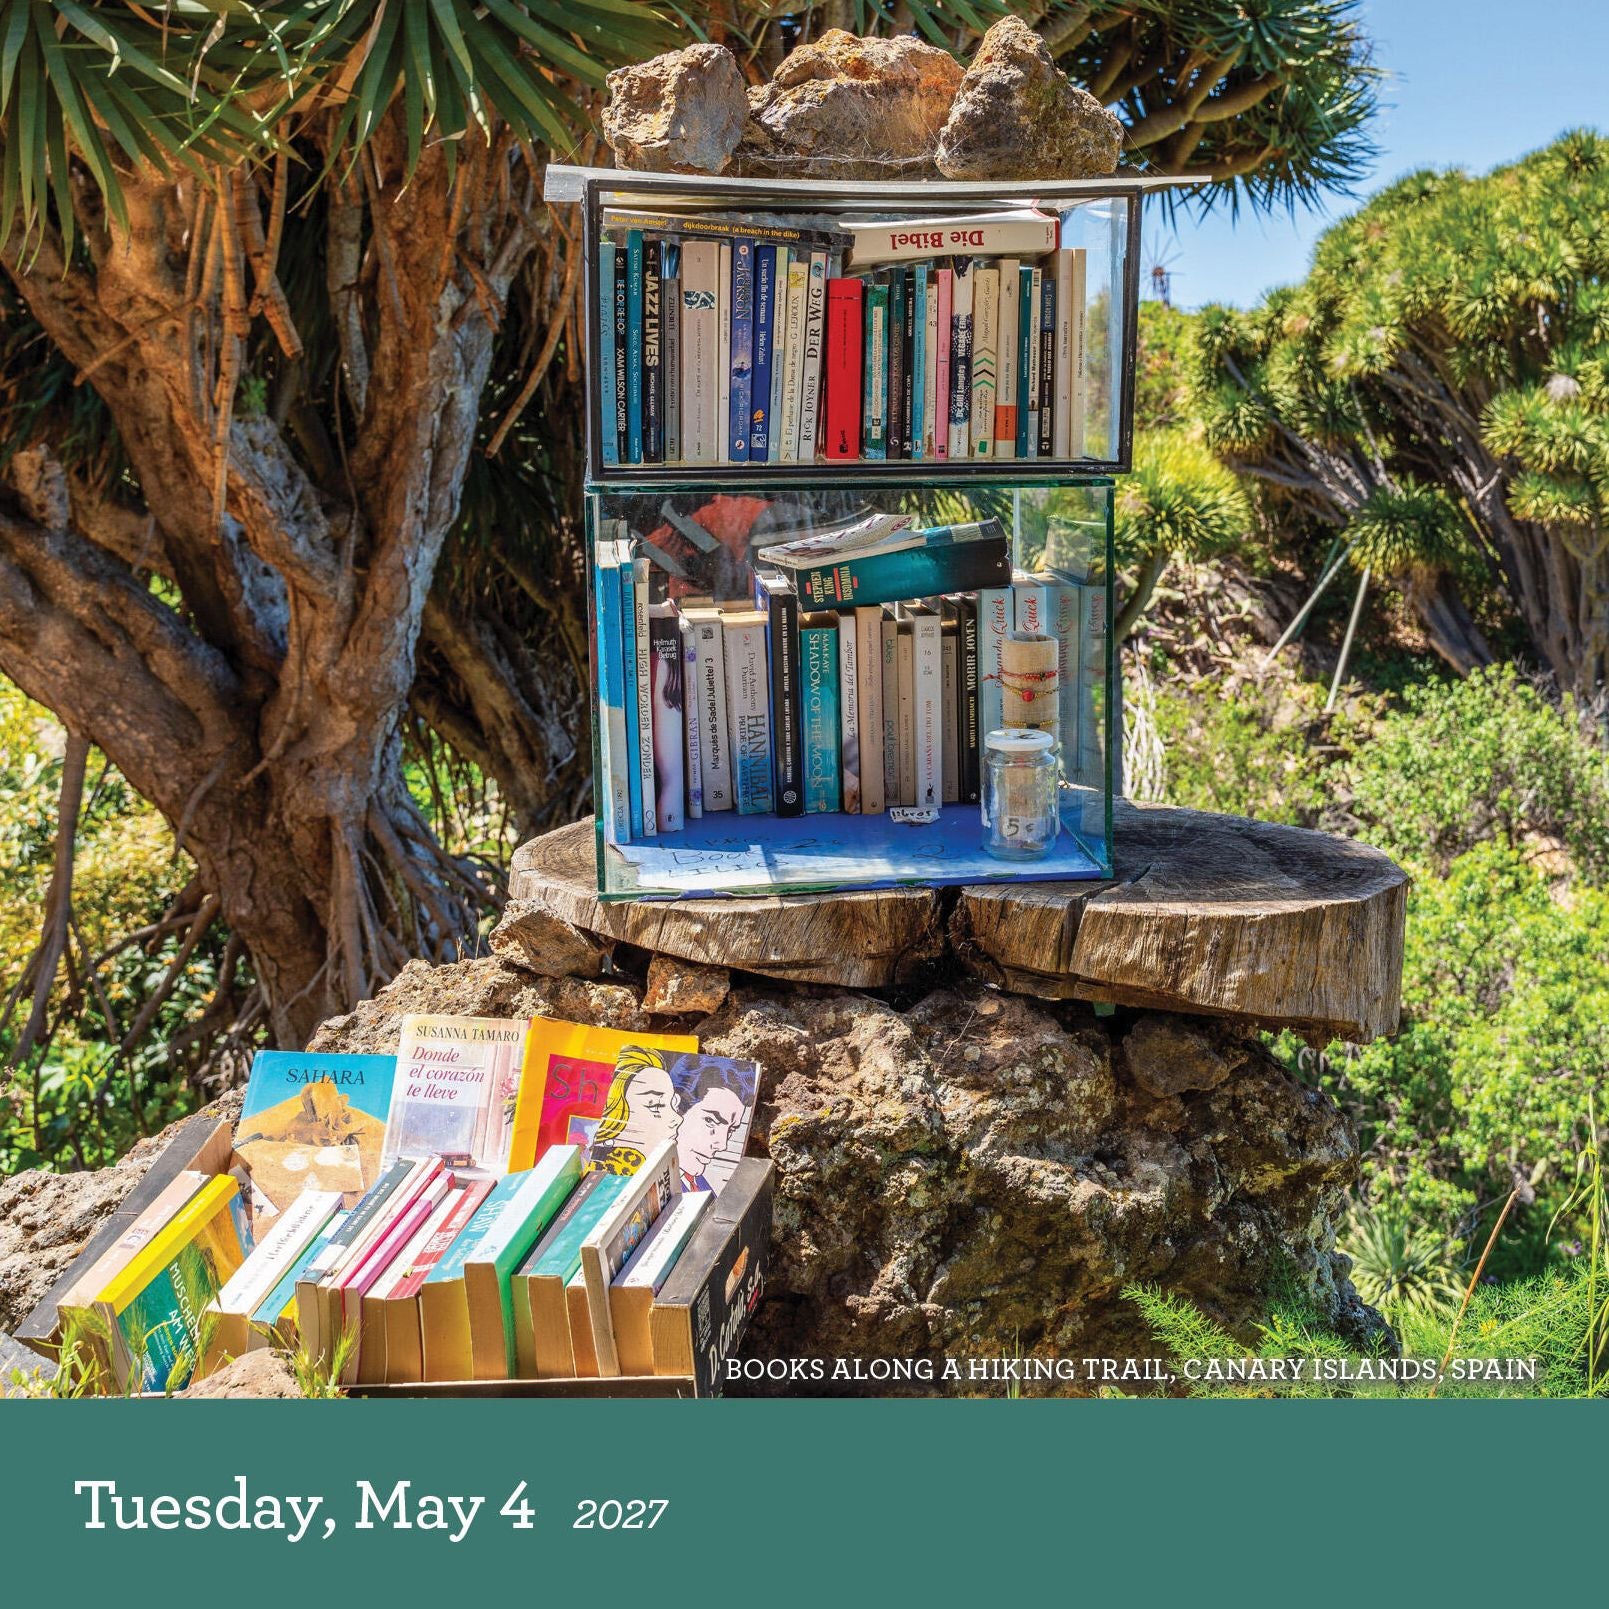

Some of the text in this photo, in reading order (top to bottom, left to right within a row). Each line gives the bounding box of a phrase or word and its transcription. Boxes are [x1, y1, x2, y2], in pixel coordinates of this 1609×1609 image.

[741, 226, 763, 237] breach
[771, 230, 782, 239] the
[782, 231, 800, 240] dike)
[890, 229, 985, 250] Die Bibel
[632, 272, 640, 296] KUMAR
[760, 268, 769, 283] sucio
[735, 261, 750, 320] JACKSON
[645, 271, 659, 367] JAZZ LIVES
[759, 301, 768, 324] semana
[791, 295, 799, 329] LEROUX
[807, 287, 822, 359] DER WEG
[758, 331, 768, 347] Helen
[616, 348, 626, 367] XAM
[616, 368, 626, 399] WILSON
[957, 365, 966, 394] Langley
[803, 376, 815, 441] RICK JOYNER
[756, 424, 763, 432] 72
[811, 571, 825, 604] STEPHEN
[824, 577, 834, 596] KING
[637, 602, 647, 638] rosenfeld
[990, 597, 1008, 636] Quick
[1022, 596, 1041, 634] Quick
[965, 618, 977, 691] MORIR JOVEN
[748, 652, 758, 711] David Anthony
[845, 640, 856, 738] La Memoria del Tambor
[638, 649, 652, 780] HIGH WORDEN ZONDER
[808, 633, 822, 788] SHADOW OF THE MOON
[690, 717, 700, 766] GIBRAN
[738, 715, 747, 742] PRIDE
[739, 744, 748, 758] OF
[747, 714, 767, 807] HANNIBAL
[712, 789, 724, 800] 35
[1006, 818, 1020, 837] 5
[415, 1025, 520, 1043] SUSANNA TAMARO
[412, 1046, 459, 1063] Donde
[286, 1068, 365, 1086] SAHARA
[409, 1066, 485, 1084] el corazón
[406, 1083, 458, 1100] te lleve
[168, 1309, 185, 1335] AM
